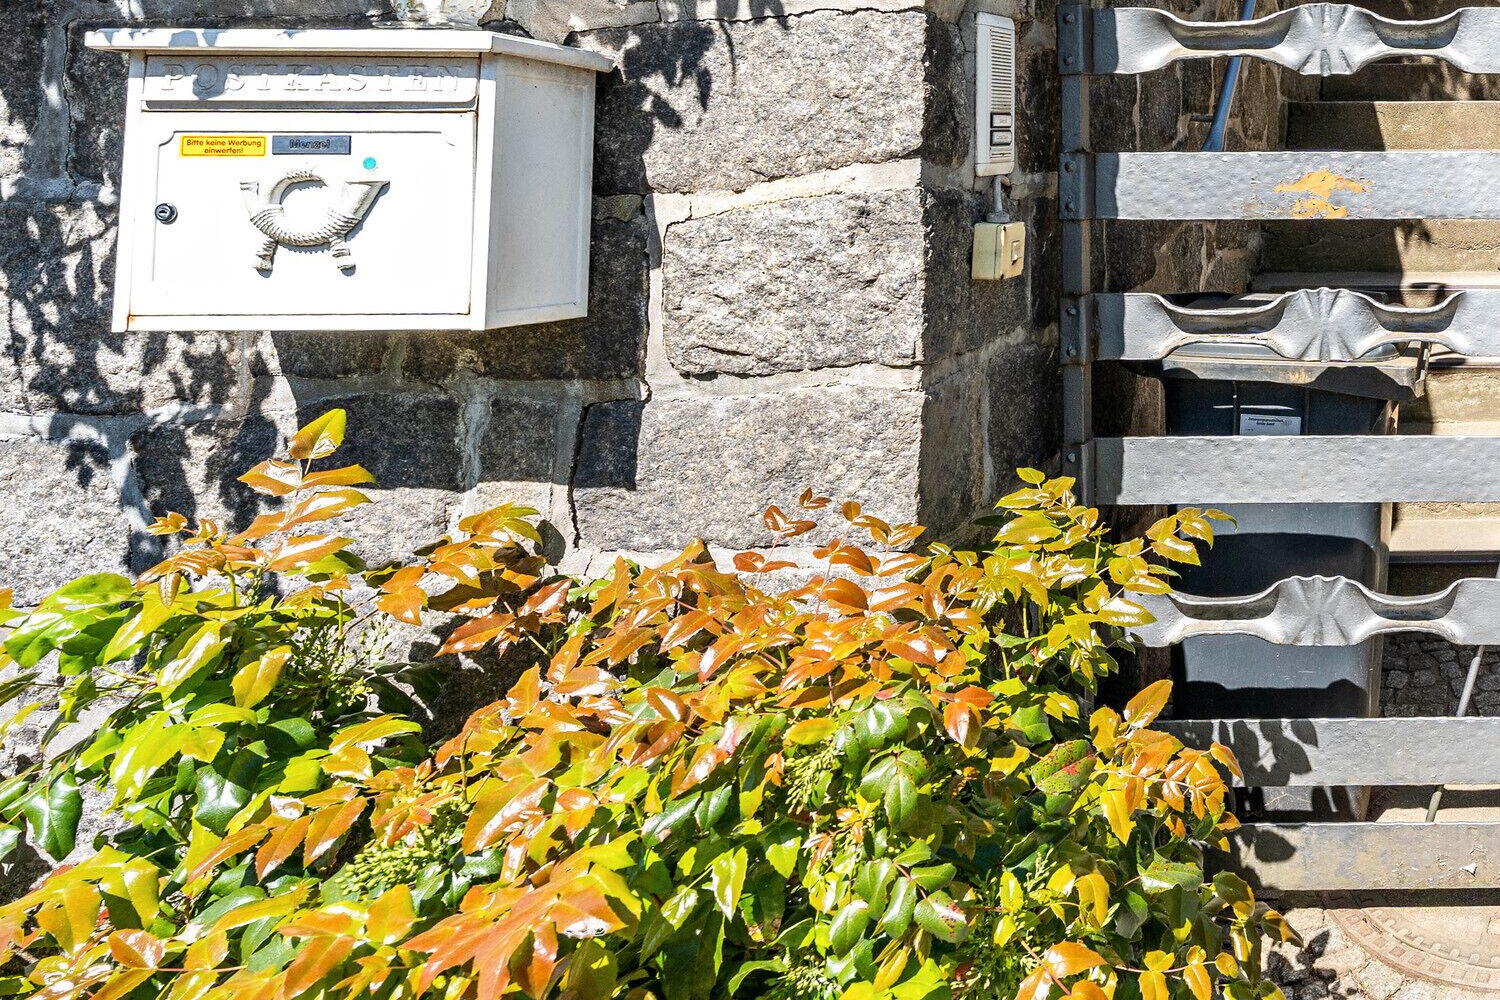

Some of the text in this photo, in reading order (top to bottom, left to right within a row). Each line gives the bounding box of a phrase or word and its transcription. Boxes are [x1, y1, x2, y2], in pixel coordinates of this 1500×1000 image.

[160, 63, 462, 92] POSTKASTEN
[186, 138, 262, 148] Bitte keine Werbung
